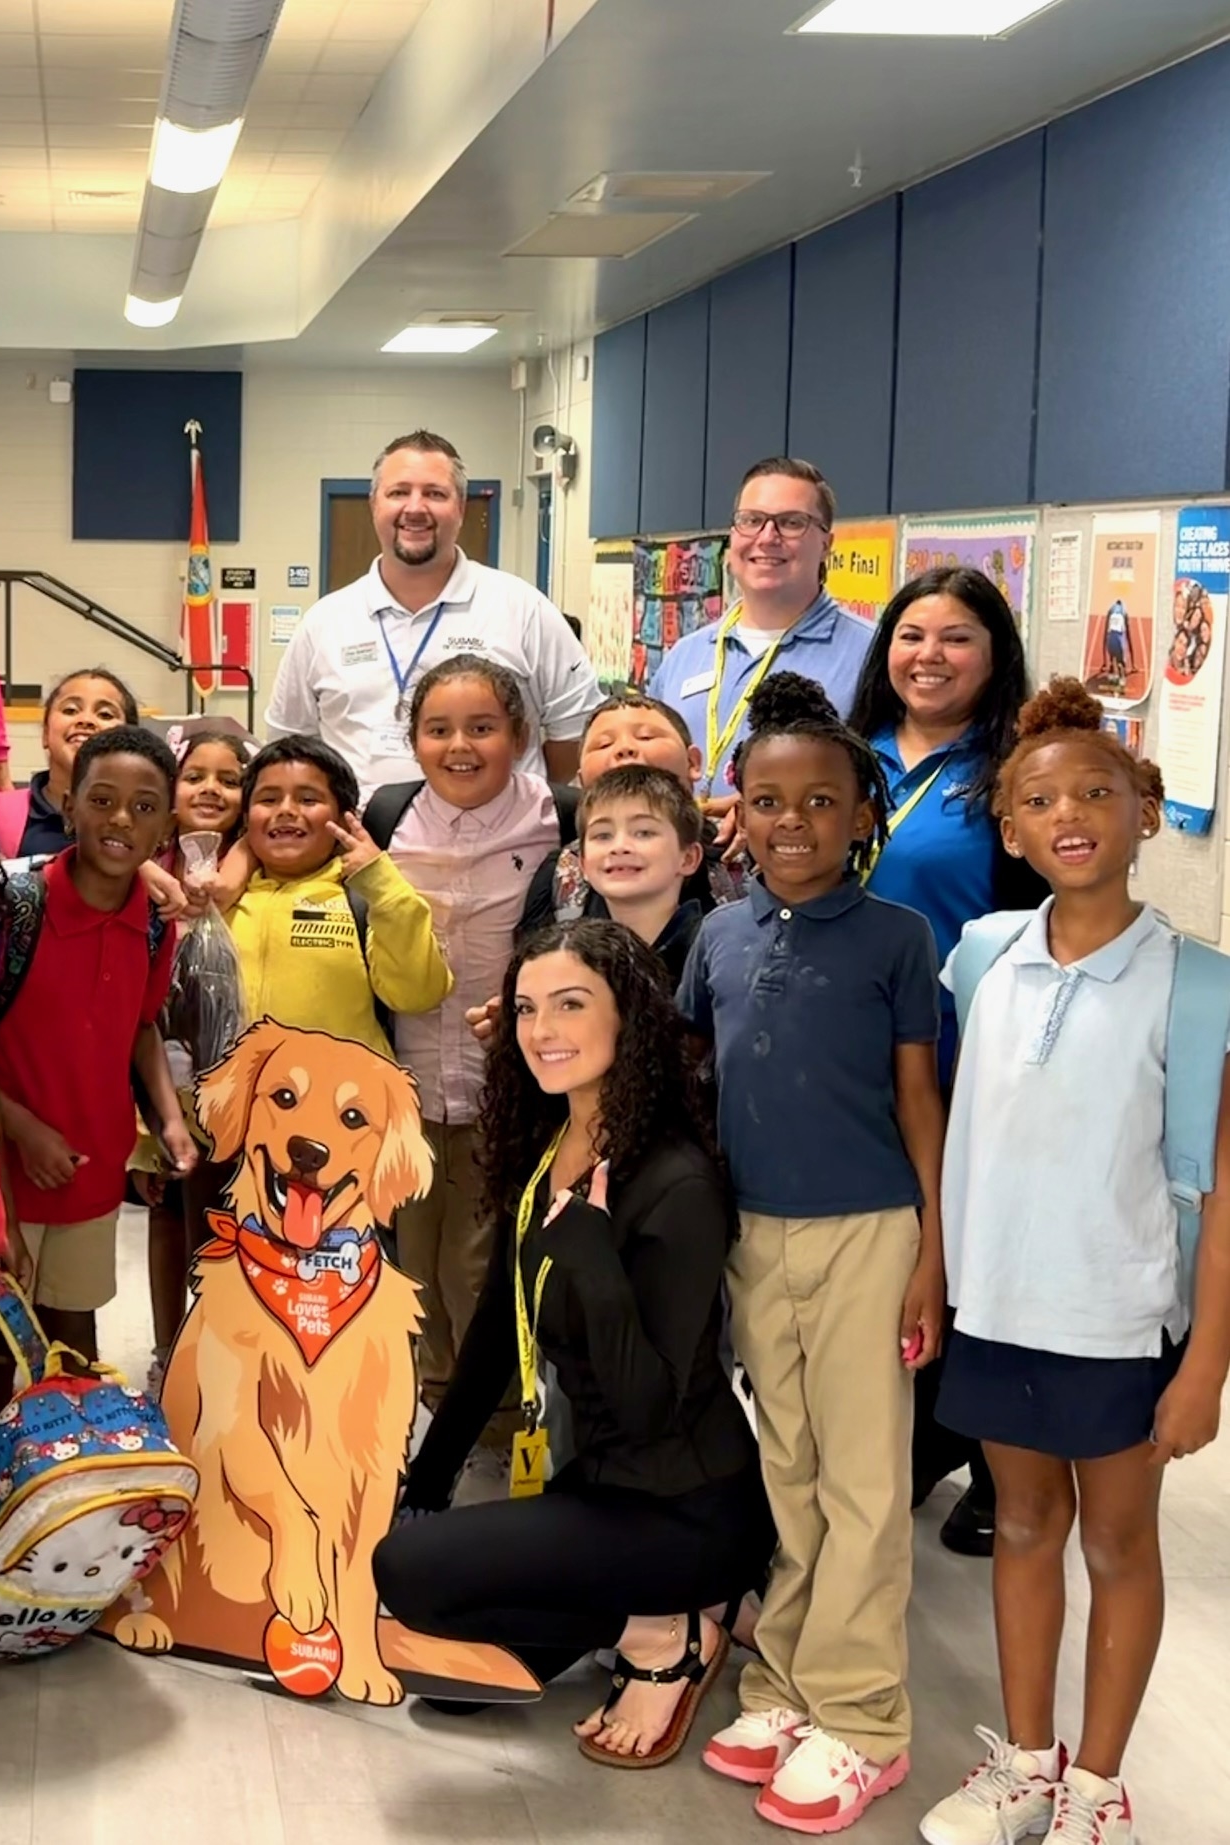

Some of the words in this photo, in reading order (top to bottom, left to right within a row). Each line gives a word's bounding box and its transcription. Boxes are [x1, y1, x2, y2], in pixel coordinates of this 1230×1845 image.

[1179, 542, 1198, 557] SAFE
[1198, 541, 1230, 557] PLACES
[827, 549, 844, 571] The
[850, 551, 880, 577] Final
[447, 637, 484, 647] SUBARU
[291, 937, 334, 947] ELECTRIC
[305, 1255, 352, 1270] FETCH
[298, 1292, 329, 1304] SUBARU
[287, 1299, 330, 1319] Loves
[296, 1316, 331, 1337] Pets
[43, 1413, 73, 1430] KITTY
[520, 1445, 541, 1476] V
[290, 1641, 338, 1663] SUBARU
